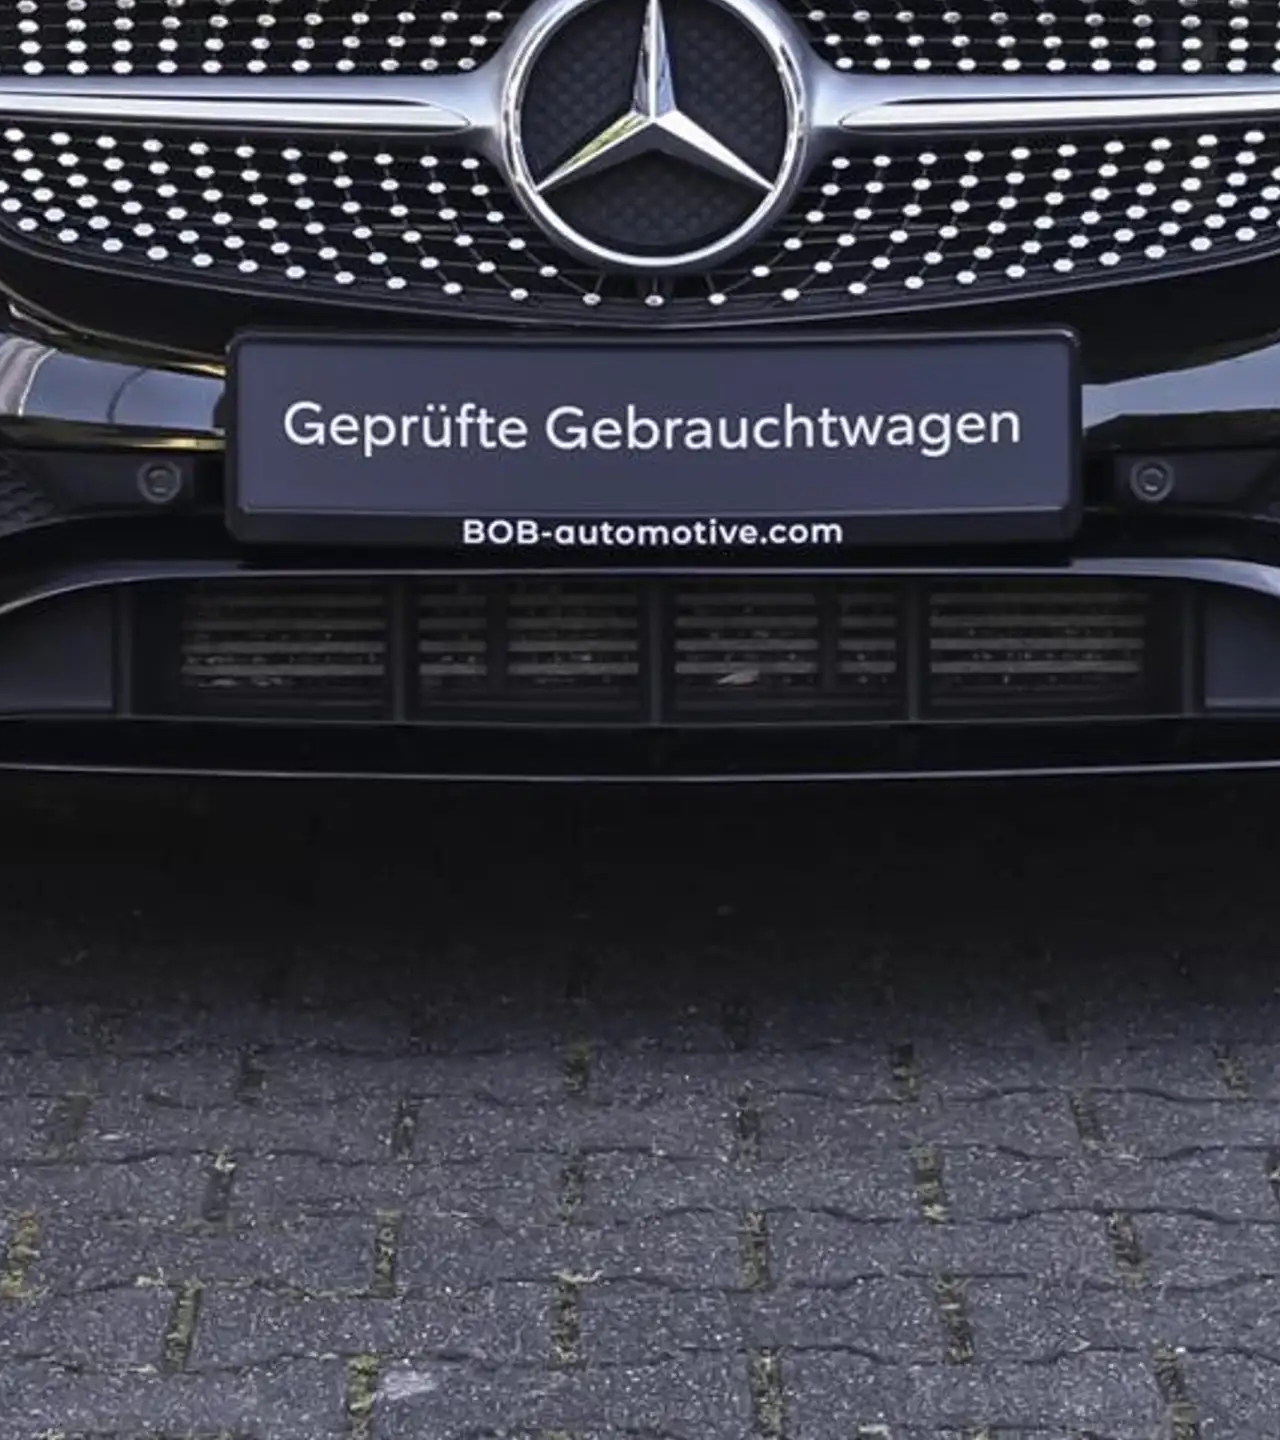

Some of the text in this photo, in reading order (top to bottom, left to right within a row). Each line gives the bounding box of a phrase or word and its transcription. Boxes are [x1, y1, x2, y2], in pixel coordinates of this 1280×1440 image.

[283, 401, 1021, 458] Geprüfte Gebrauchtwagen
[462, 518, 843, 545] BOB-automotive.com
